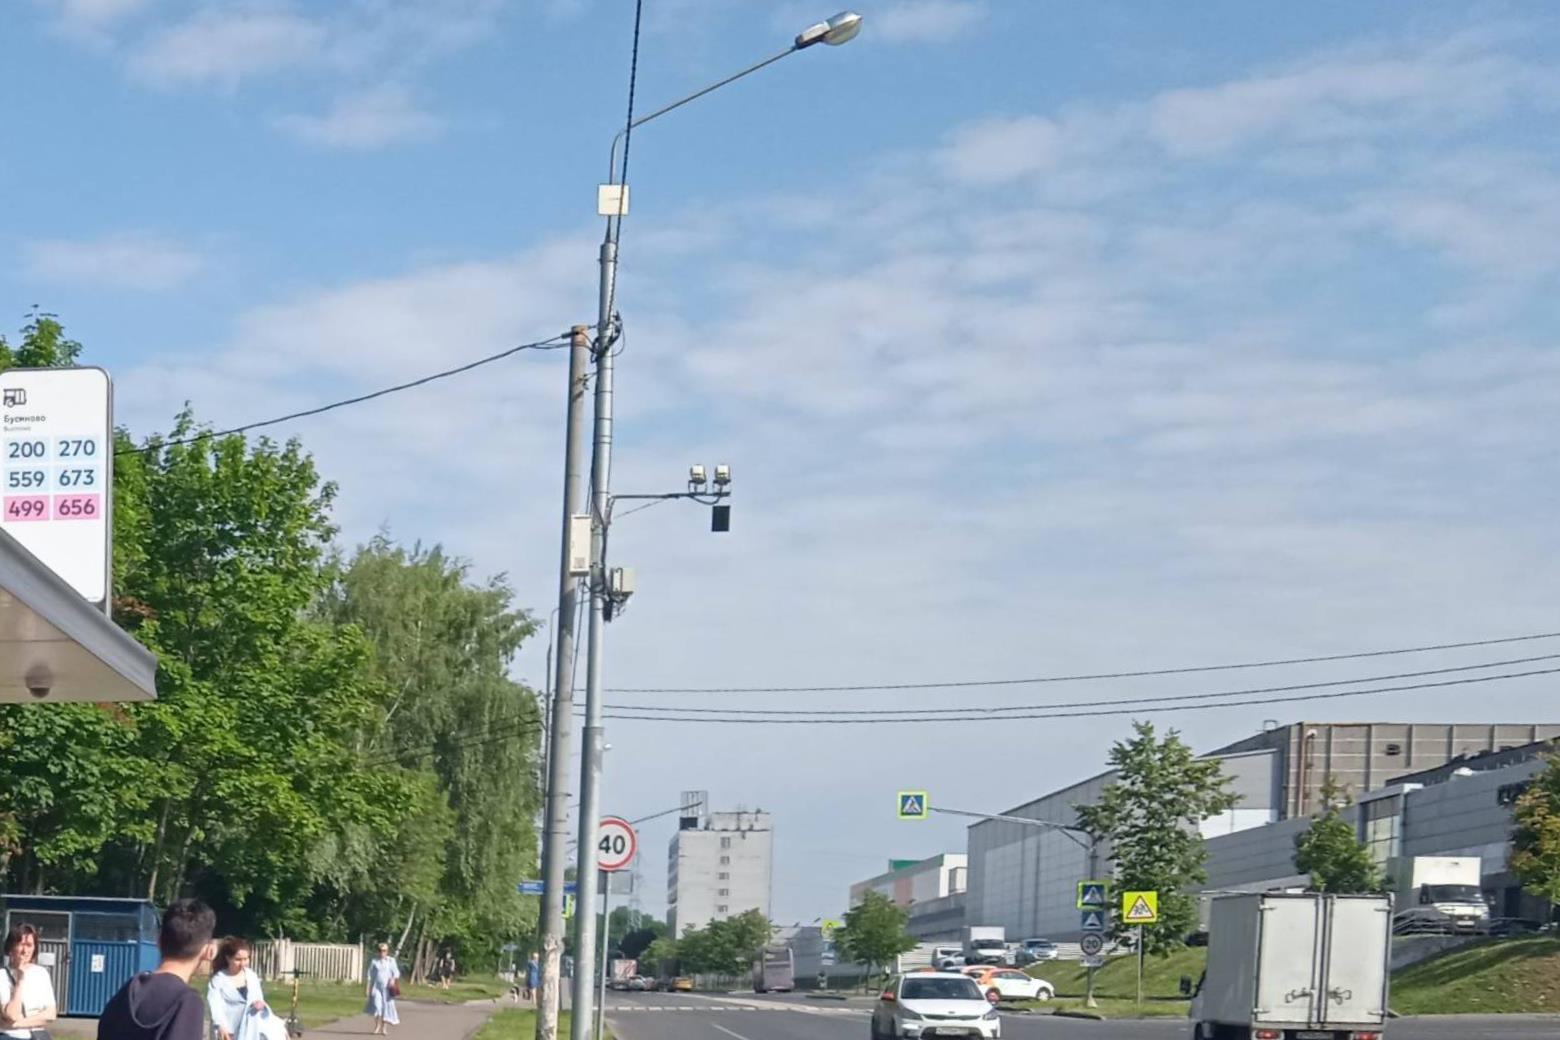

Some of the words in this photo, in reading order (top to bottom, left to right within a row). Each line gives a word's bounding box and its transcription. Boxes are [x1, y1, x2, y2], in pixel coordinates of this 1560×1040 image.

[4, 414, 46, 424] Бусиново
[9, 441, 45, 458] 200
[59, 440, 95, 457] 270
[9, 471, 45, 488] 559
[59, 469, 95, 486] 673
[8, 500, 45, 517] 499
[59, 499, 95, 516] 656
[598, 834, 626, 855] 40
